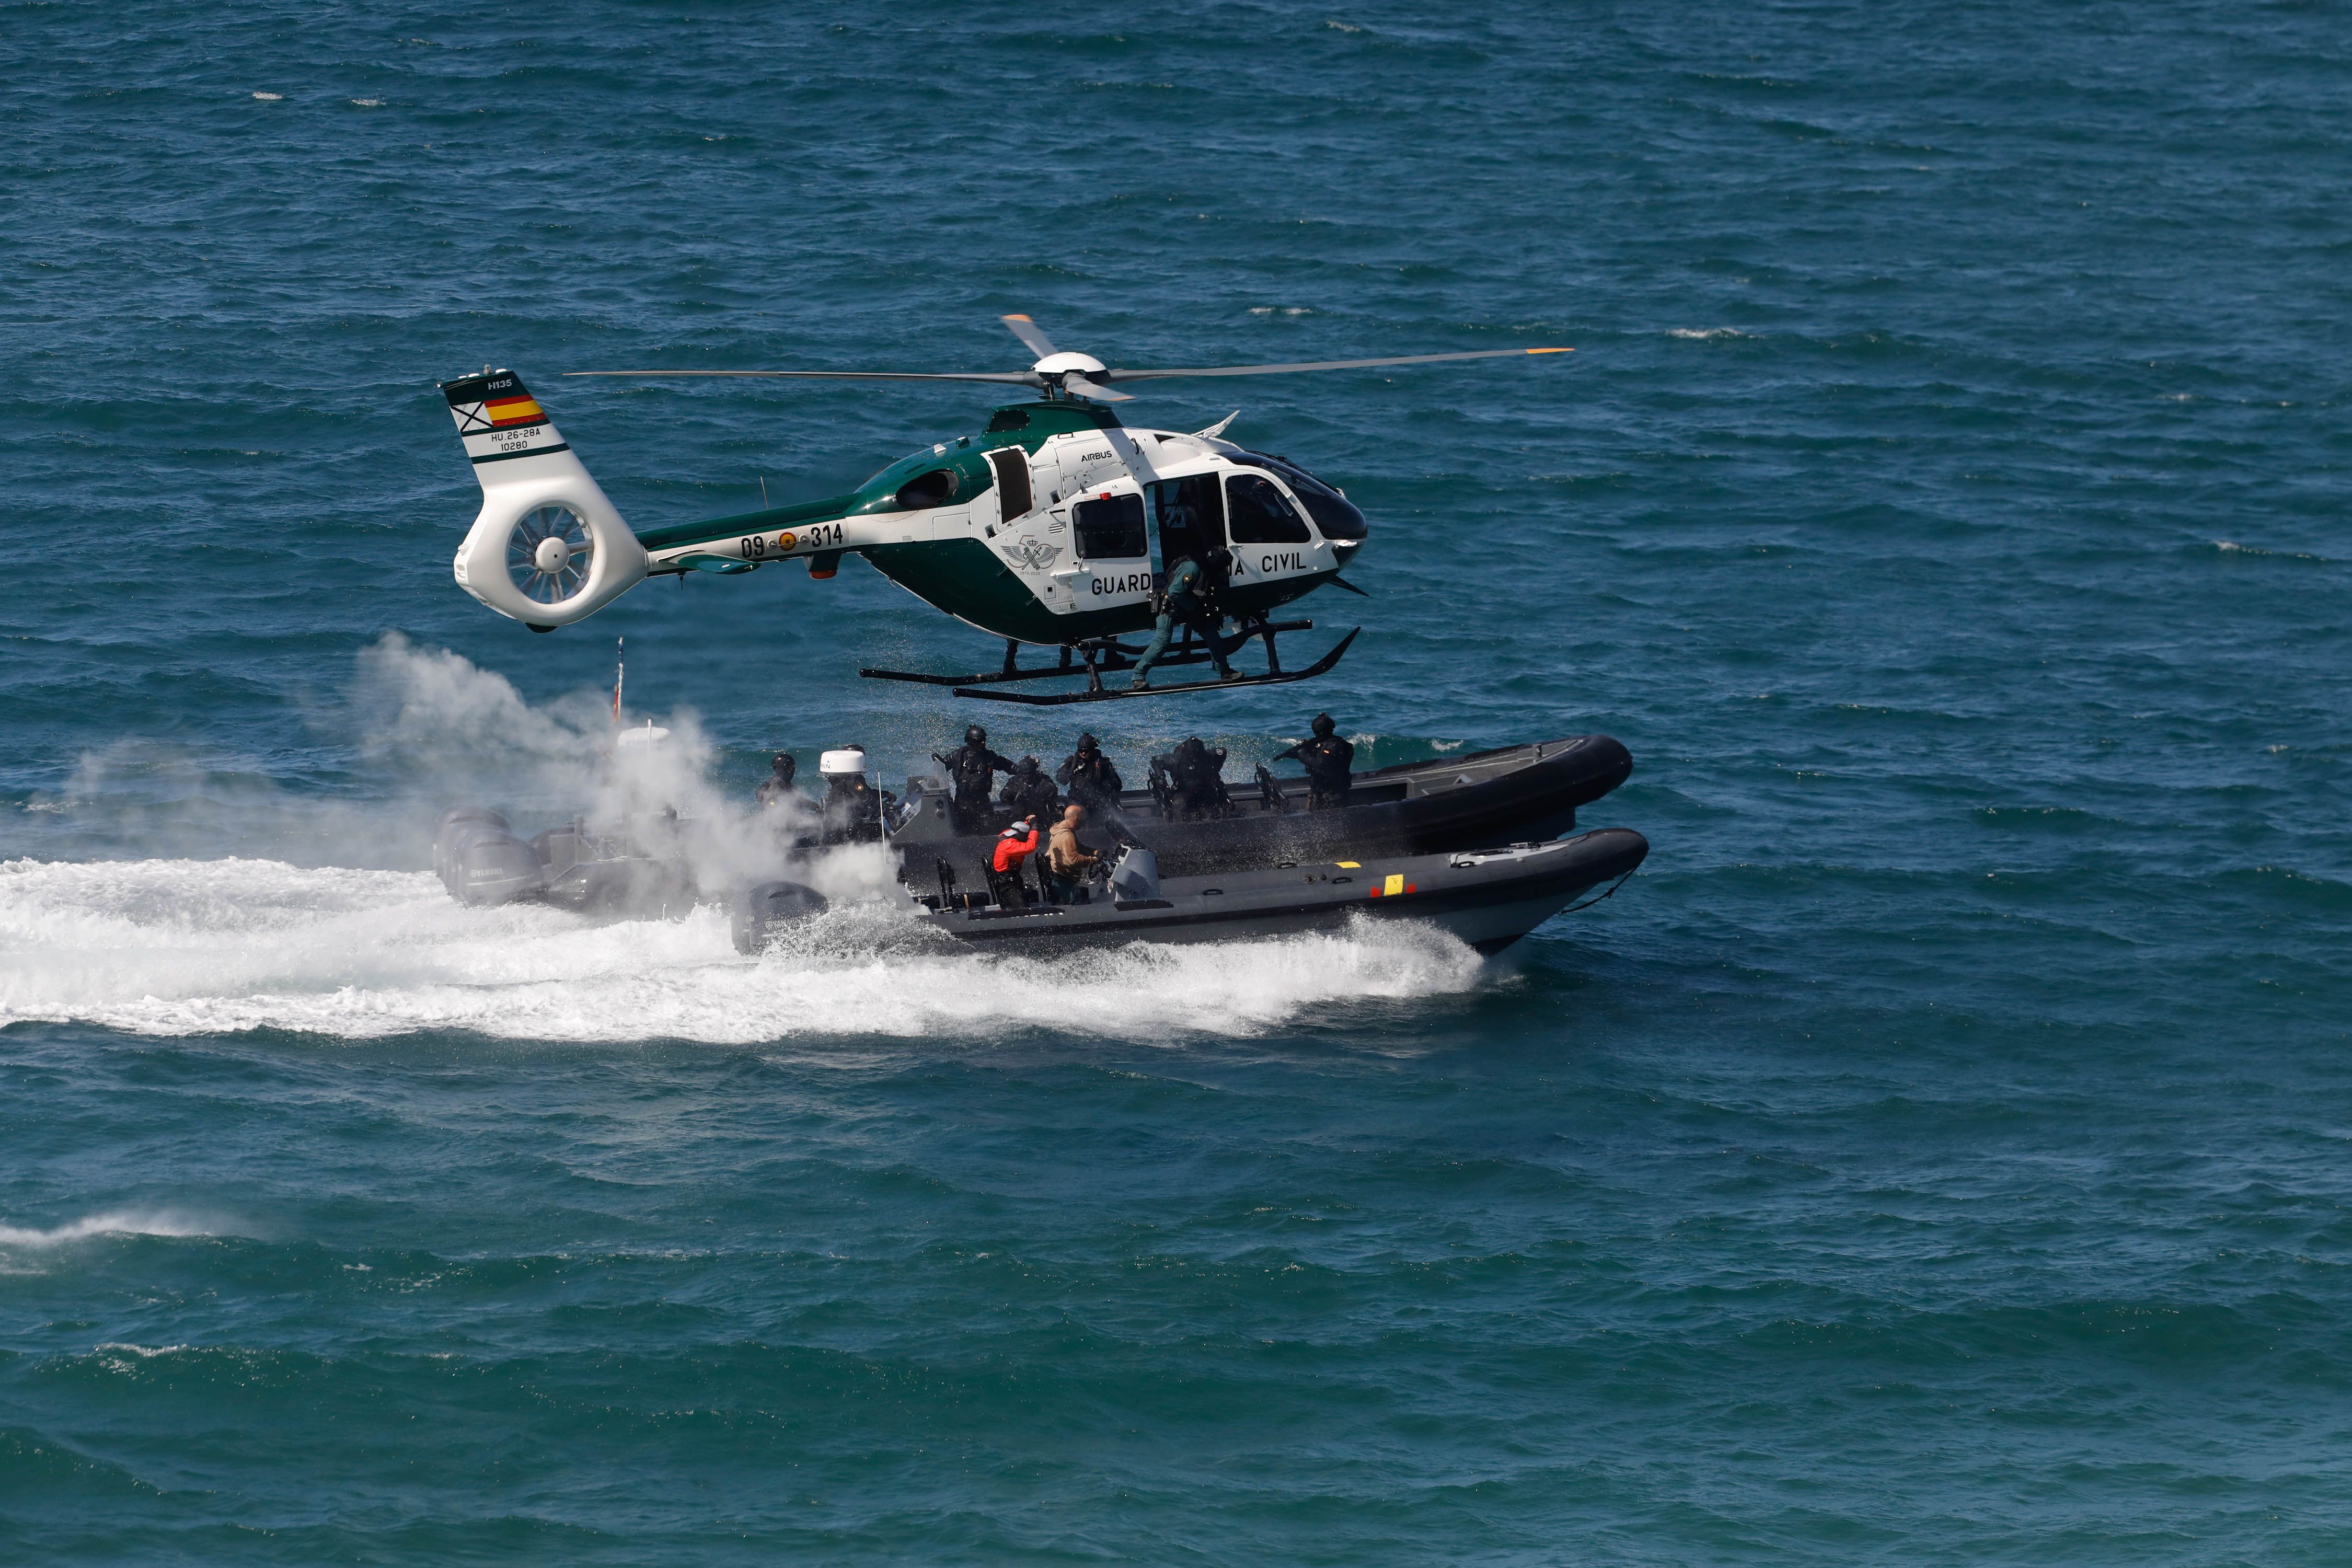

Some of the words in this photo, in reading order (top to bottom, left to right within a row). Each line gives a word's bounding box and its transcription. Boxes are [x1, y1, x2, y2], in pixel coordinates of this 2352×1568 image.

[488, 378, 512, 390] H135
[491, 428, 540, 442] HU.26-28A
[501, 441, 527, 451] 10280
[1081, 451, 1112, 462] AIRBUS
[741, 536, 765, 558] 09
[811, 523, 843, 547] 314
[1092, 573, 1151, 595] GUARD
[1262, 552, 1306, 572] CIVIL
